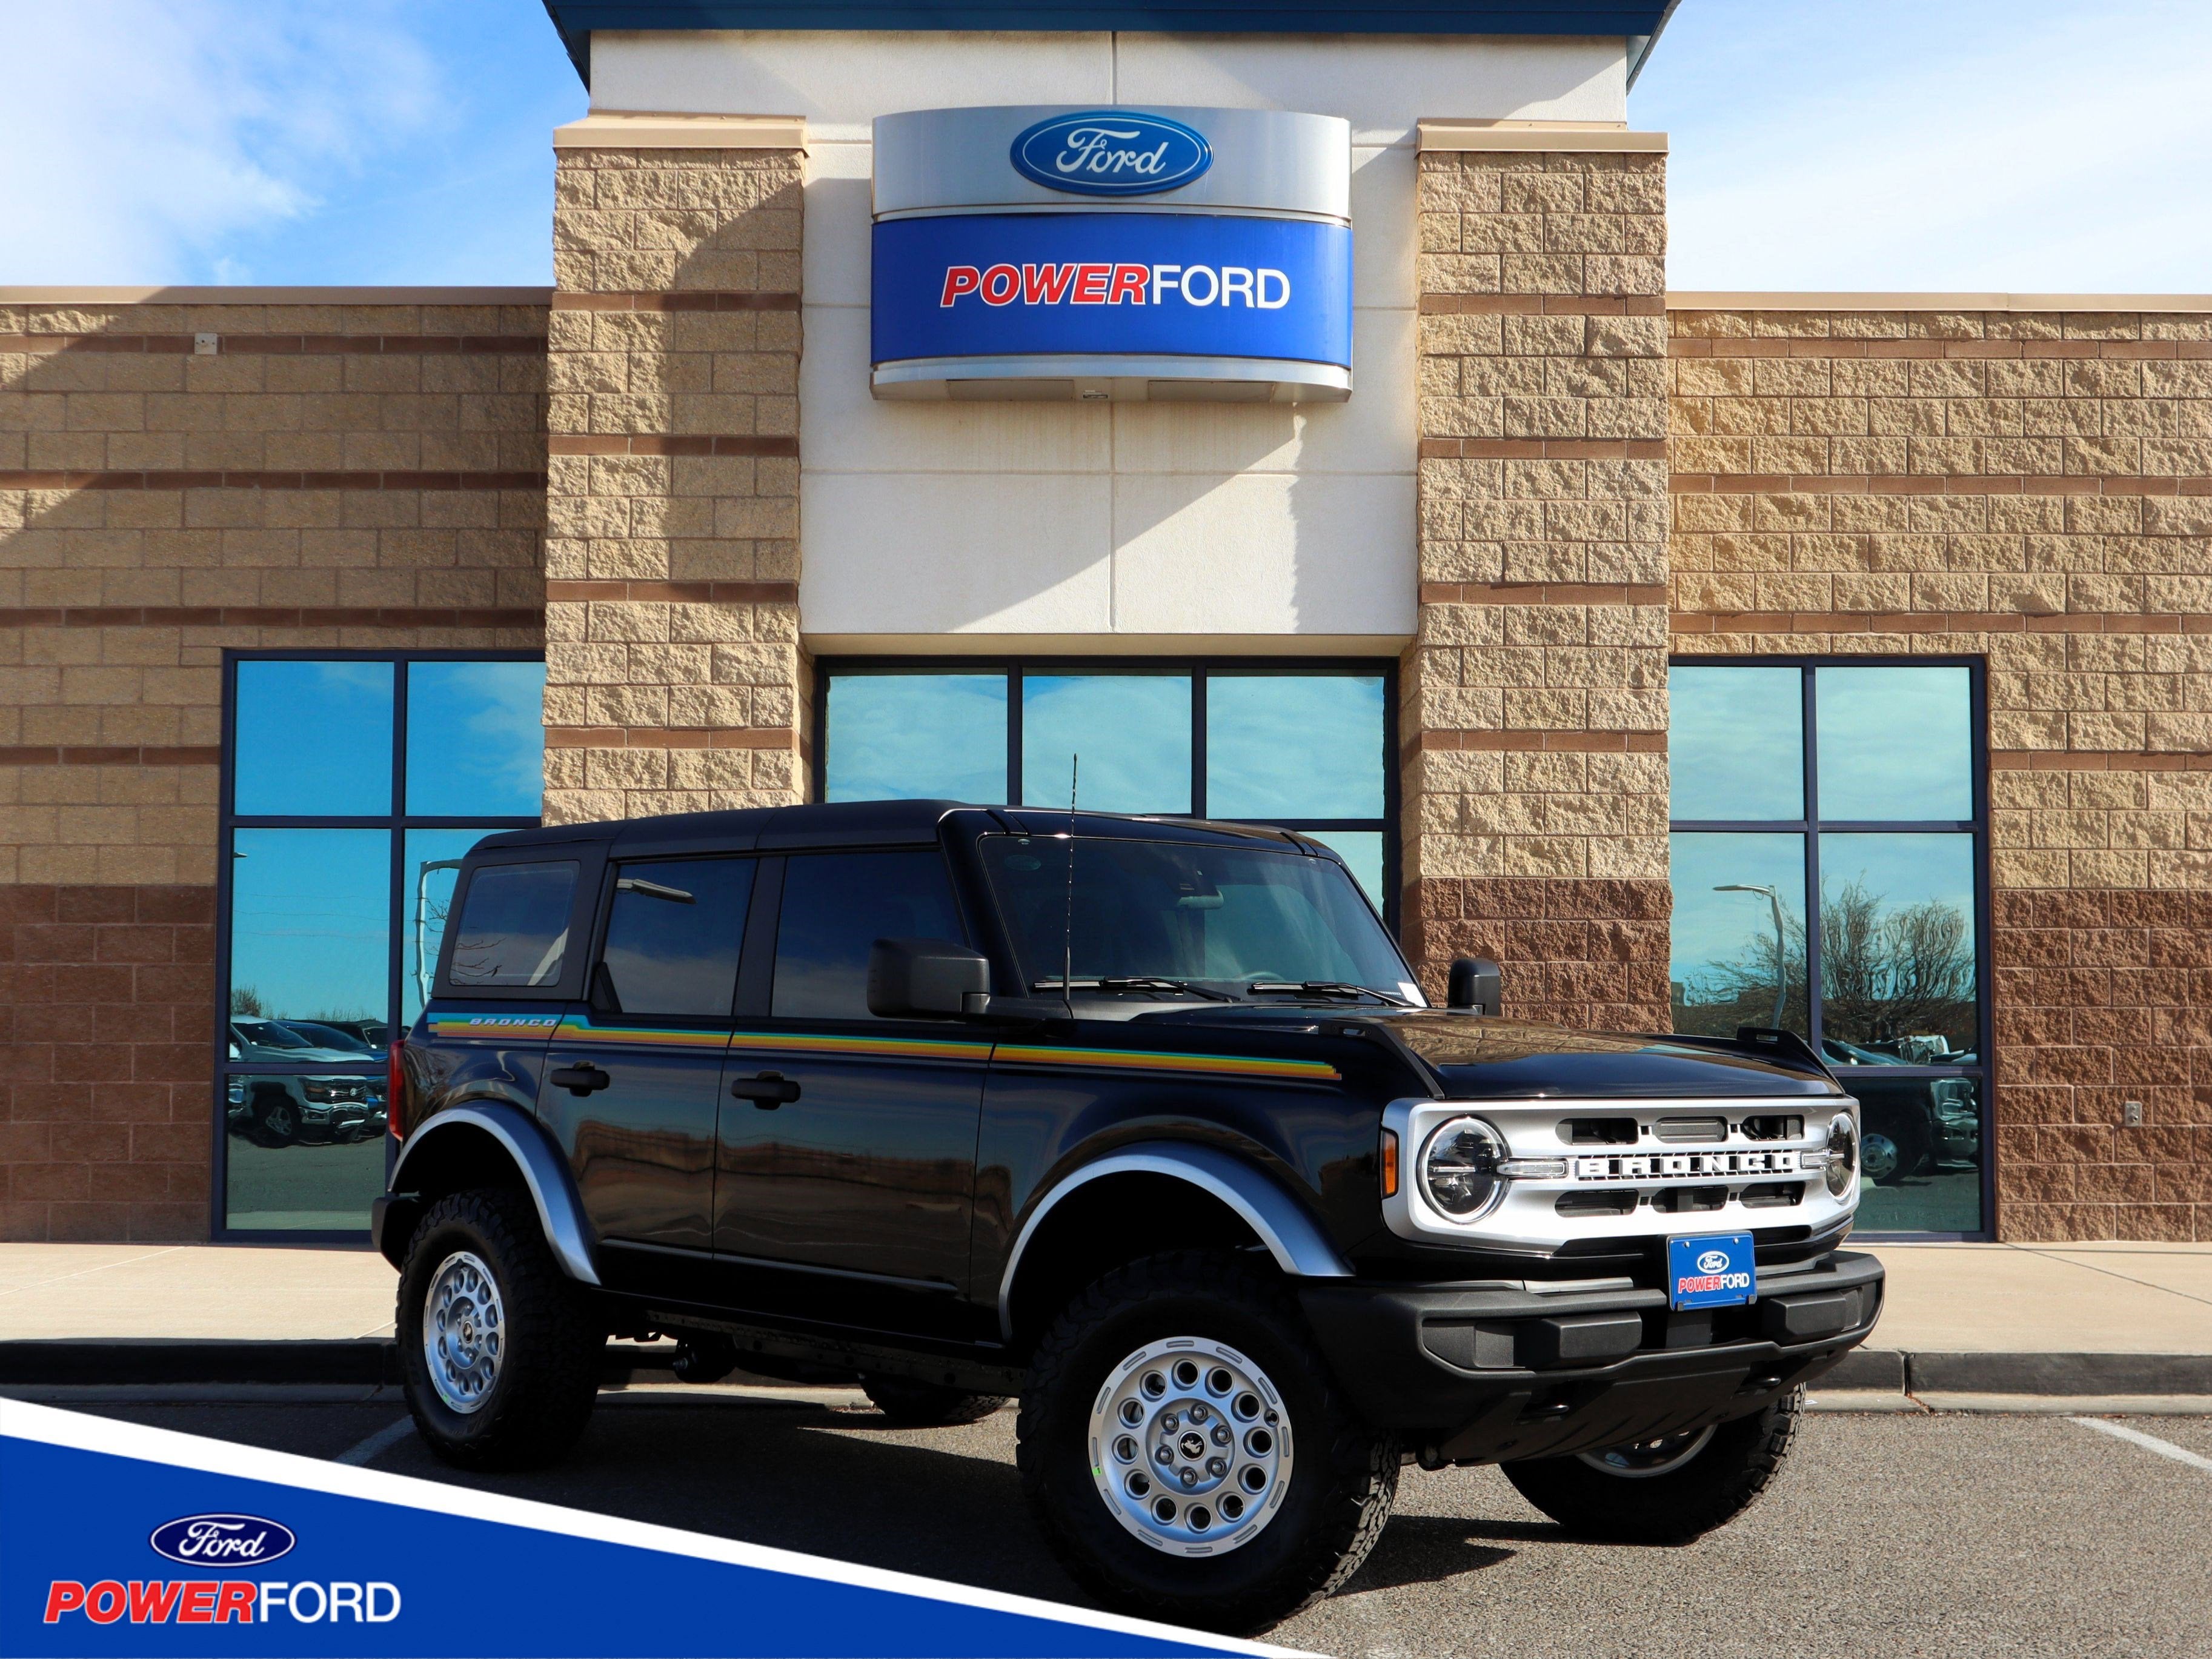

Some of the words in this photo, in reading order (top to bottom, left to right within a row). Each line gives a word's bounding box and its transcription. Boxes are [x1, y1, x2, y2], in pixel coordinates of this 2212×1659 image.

[1056, 127, 1169, 175] Ford
[940, 262, 1291, 309] POWERFORD
[469, 1017, 557, 1027] BRONCO
[1576, 1152, 1799, 1177] BRONCO
[1703, 1255, 1723, 1269] Ford
[1678, 1273, 1750, 1294] POWERFORD
